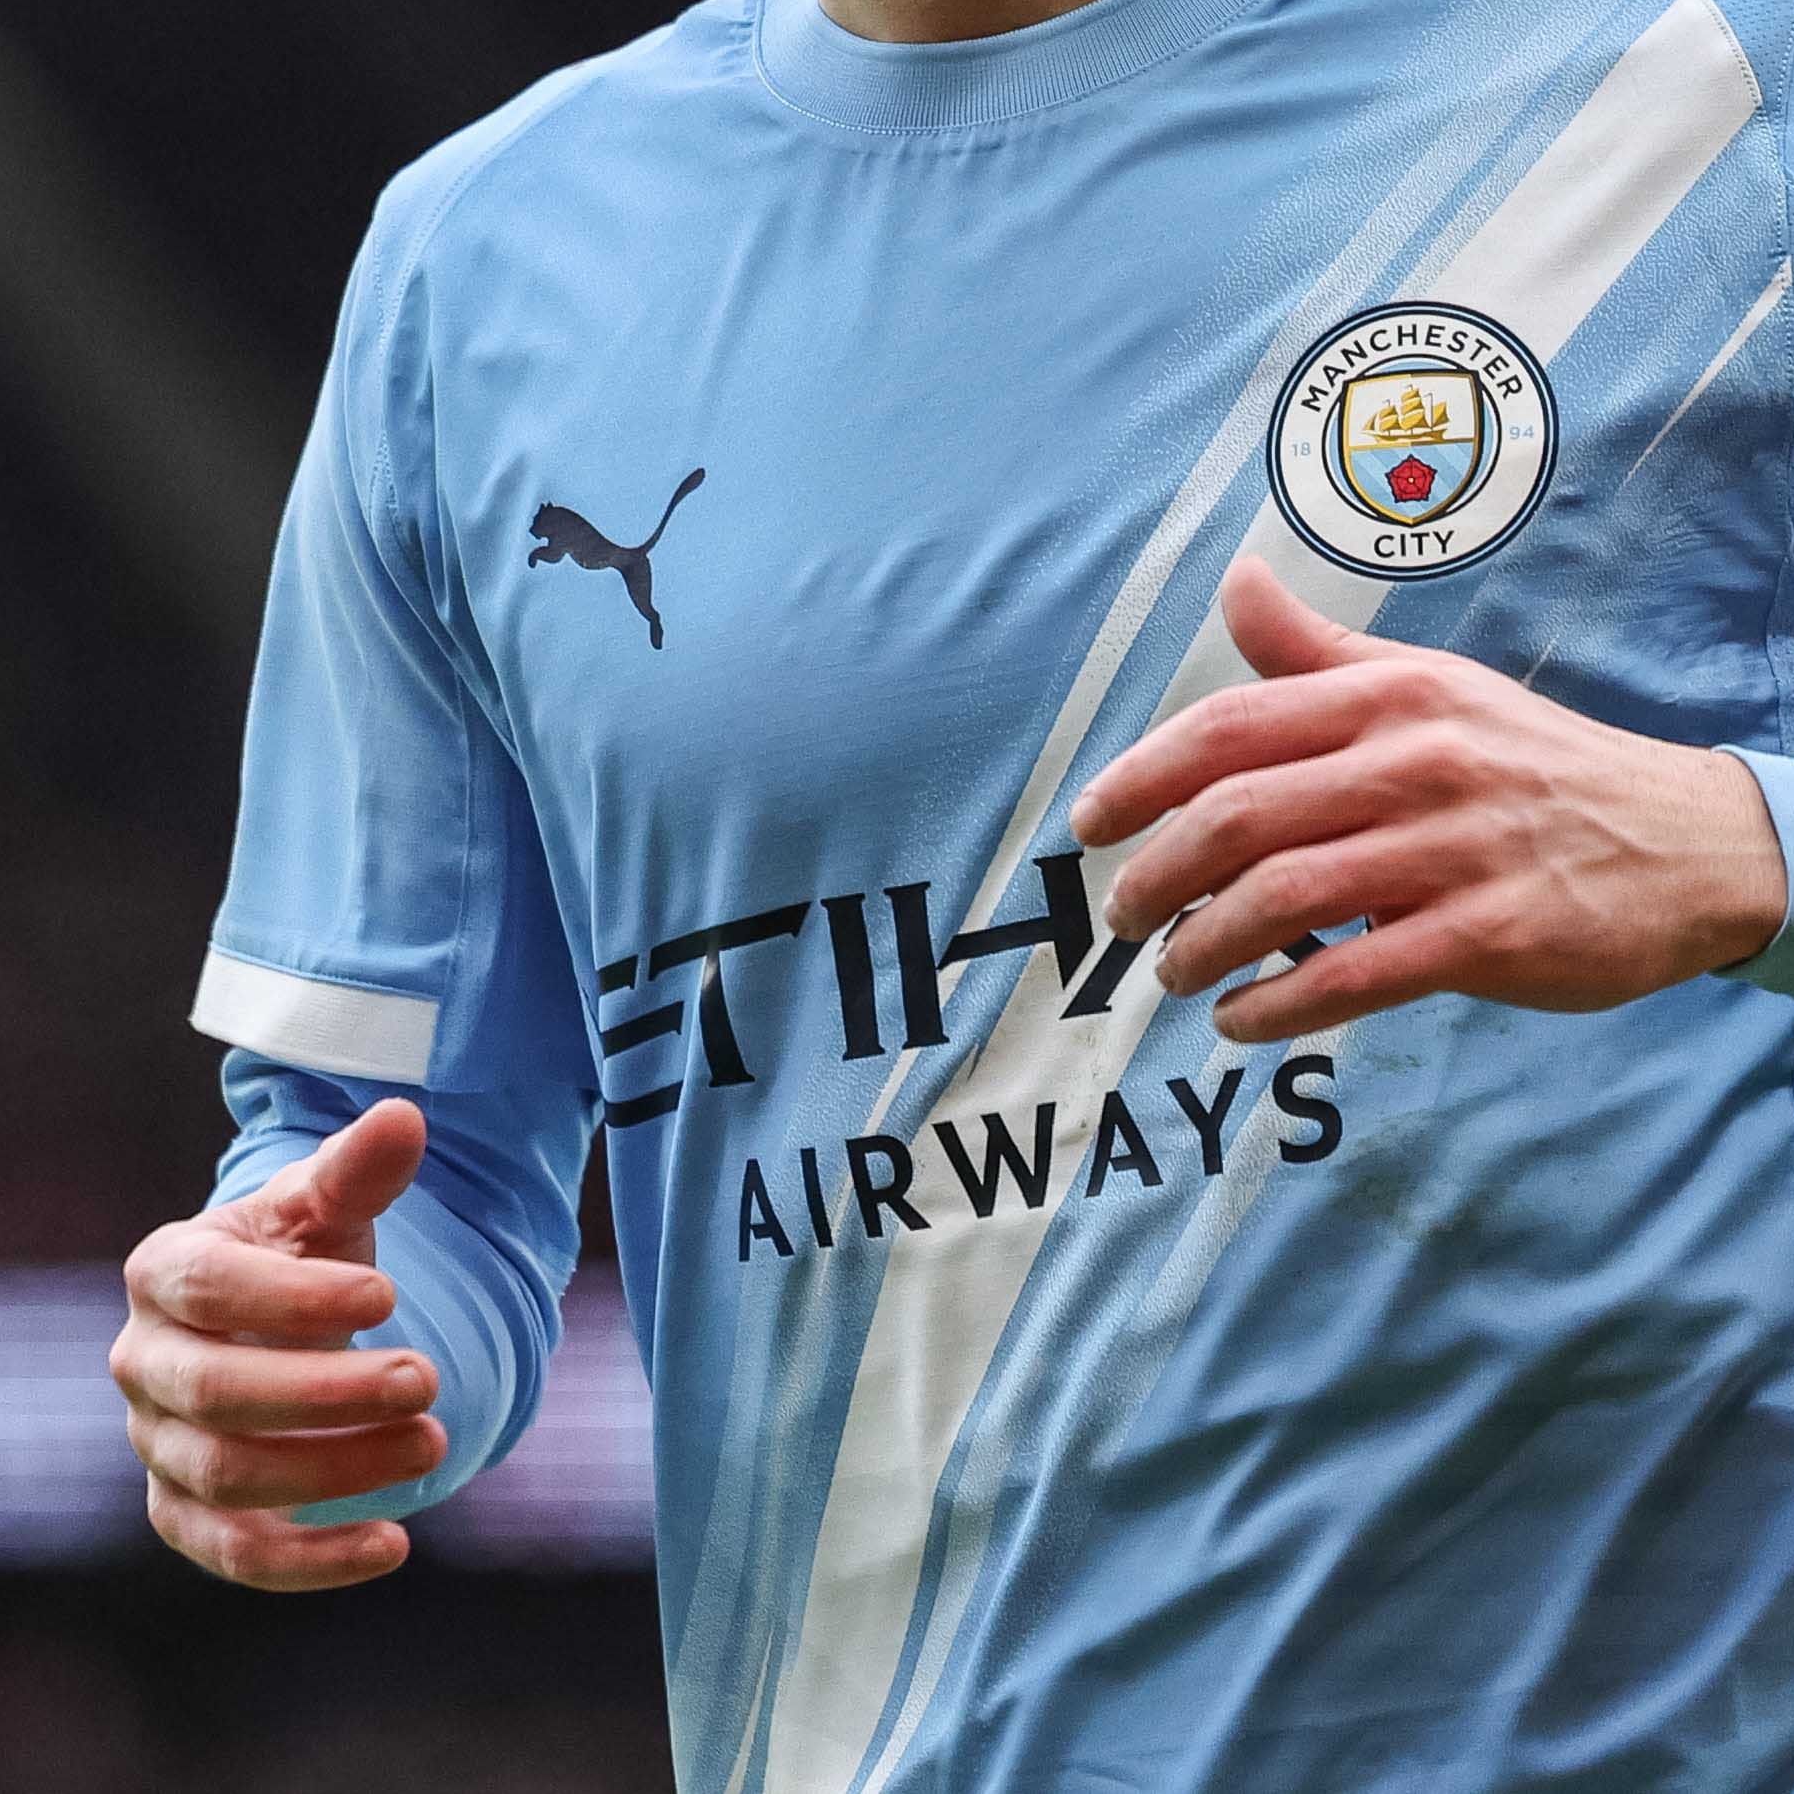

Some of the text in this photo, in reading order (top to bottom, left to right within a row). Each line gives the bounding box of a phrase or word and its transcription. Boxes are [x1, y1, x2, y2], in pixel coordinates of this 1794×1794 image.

[1300, 323, 1523, 412] MANCHESTER
[1291, 425, 1535, 458] 18 94
[1373, 530, 1455, 558] CITY
[597, 851, 1372, 1129] ETIH
[738, 1053, 1343, 1262] AIRWAYS
